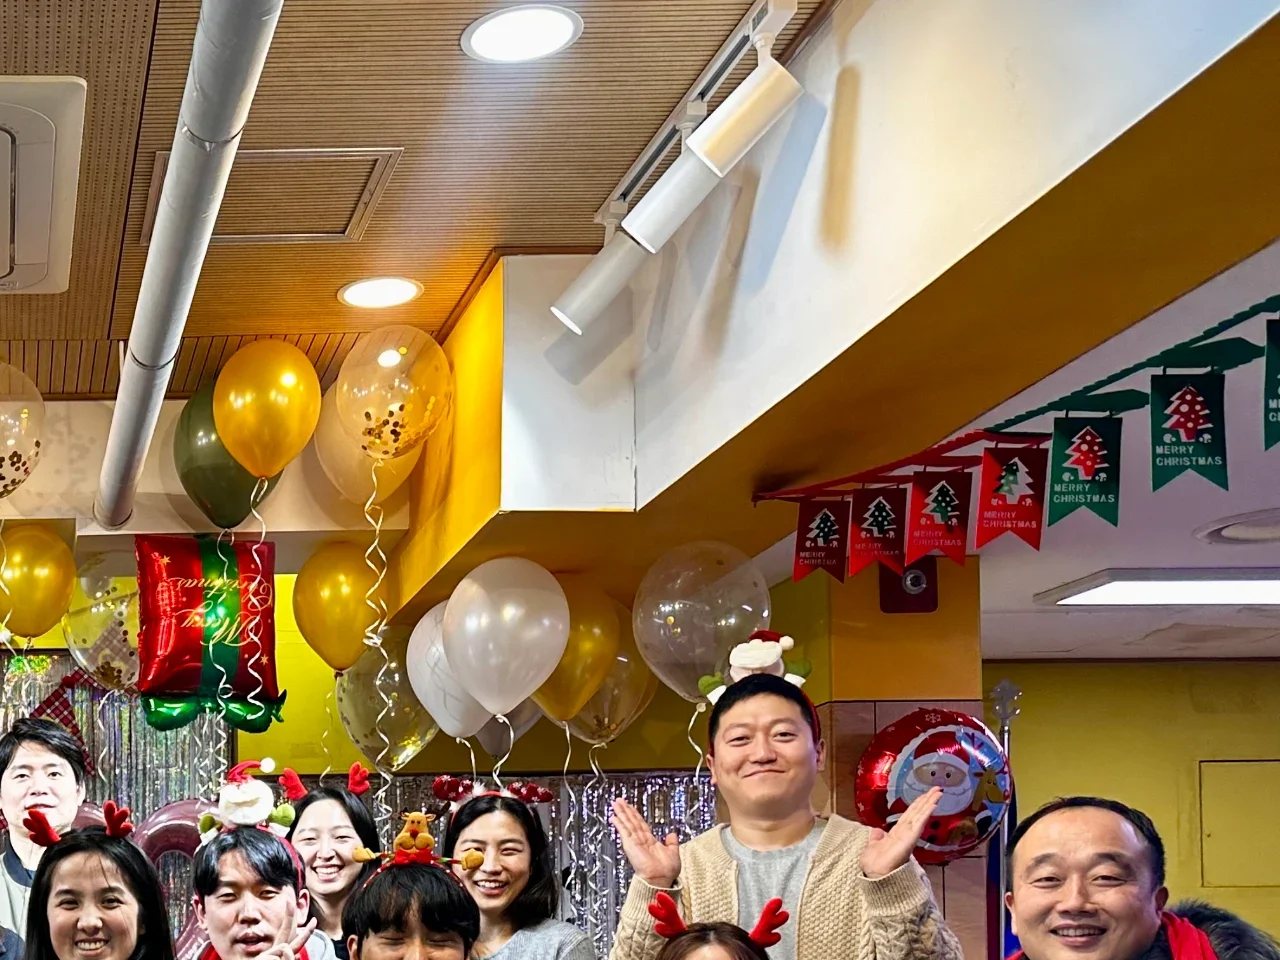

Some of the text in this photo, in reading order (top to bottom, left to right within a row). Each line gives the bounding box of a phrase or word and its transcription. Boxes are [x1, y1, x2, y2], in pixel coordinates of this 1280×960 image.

[1155, 445, 1194, 454] MERRY
[1156, 456, 1222, 466] CHRISTMAS
[1054, 483, 1090, 492] MERRY
[1053, 494, 1115, 503] CHRISTMAS
[983, 511, 1016, 519] MERRY
[983, 519, 1037, 529] CHRISTMAS
[913, 538, 962, 546] CHRISTMAS
[799, 558, 837, 566] CHRISTMA
